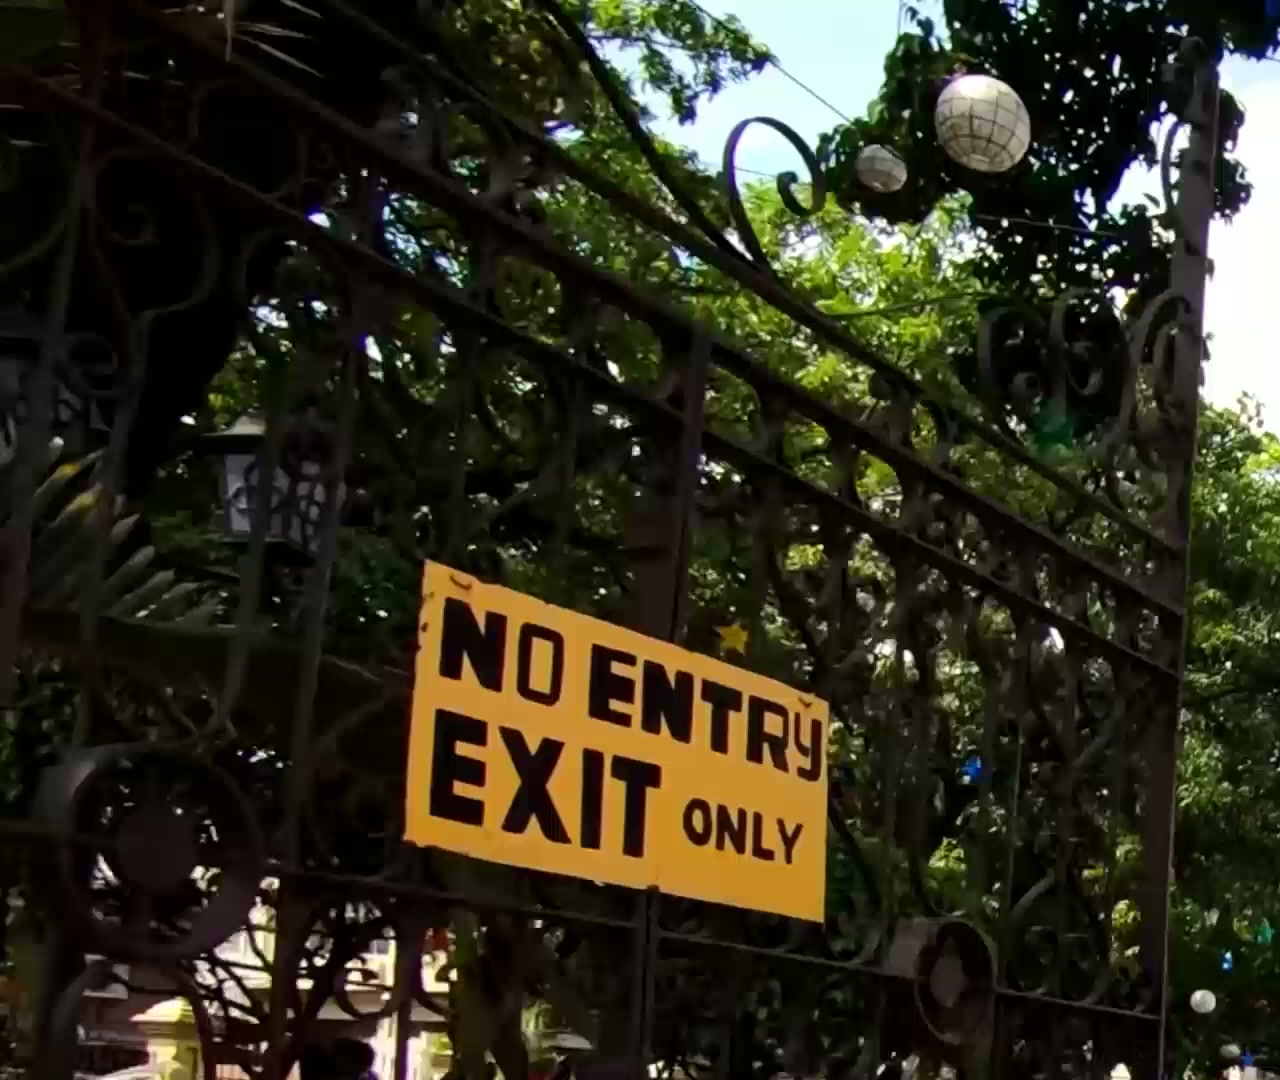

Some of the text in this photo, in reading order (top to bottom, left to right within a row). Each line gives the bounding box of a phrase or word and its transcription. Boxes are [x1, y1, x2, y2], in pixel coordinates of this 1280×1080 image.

[439, 596, 823, 782] NO ENTRY
[429, 708, 804, 864] EXIT ONLY
